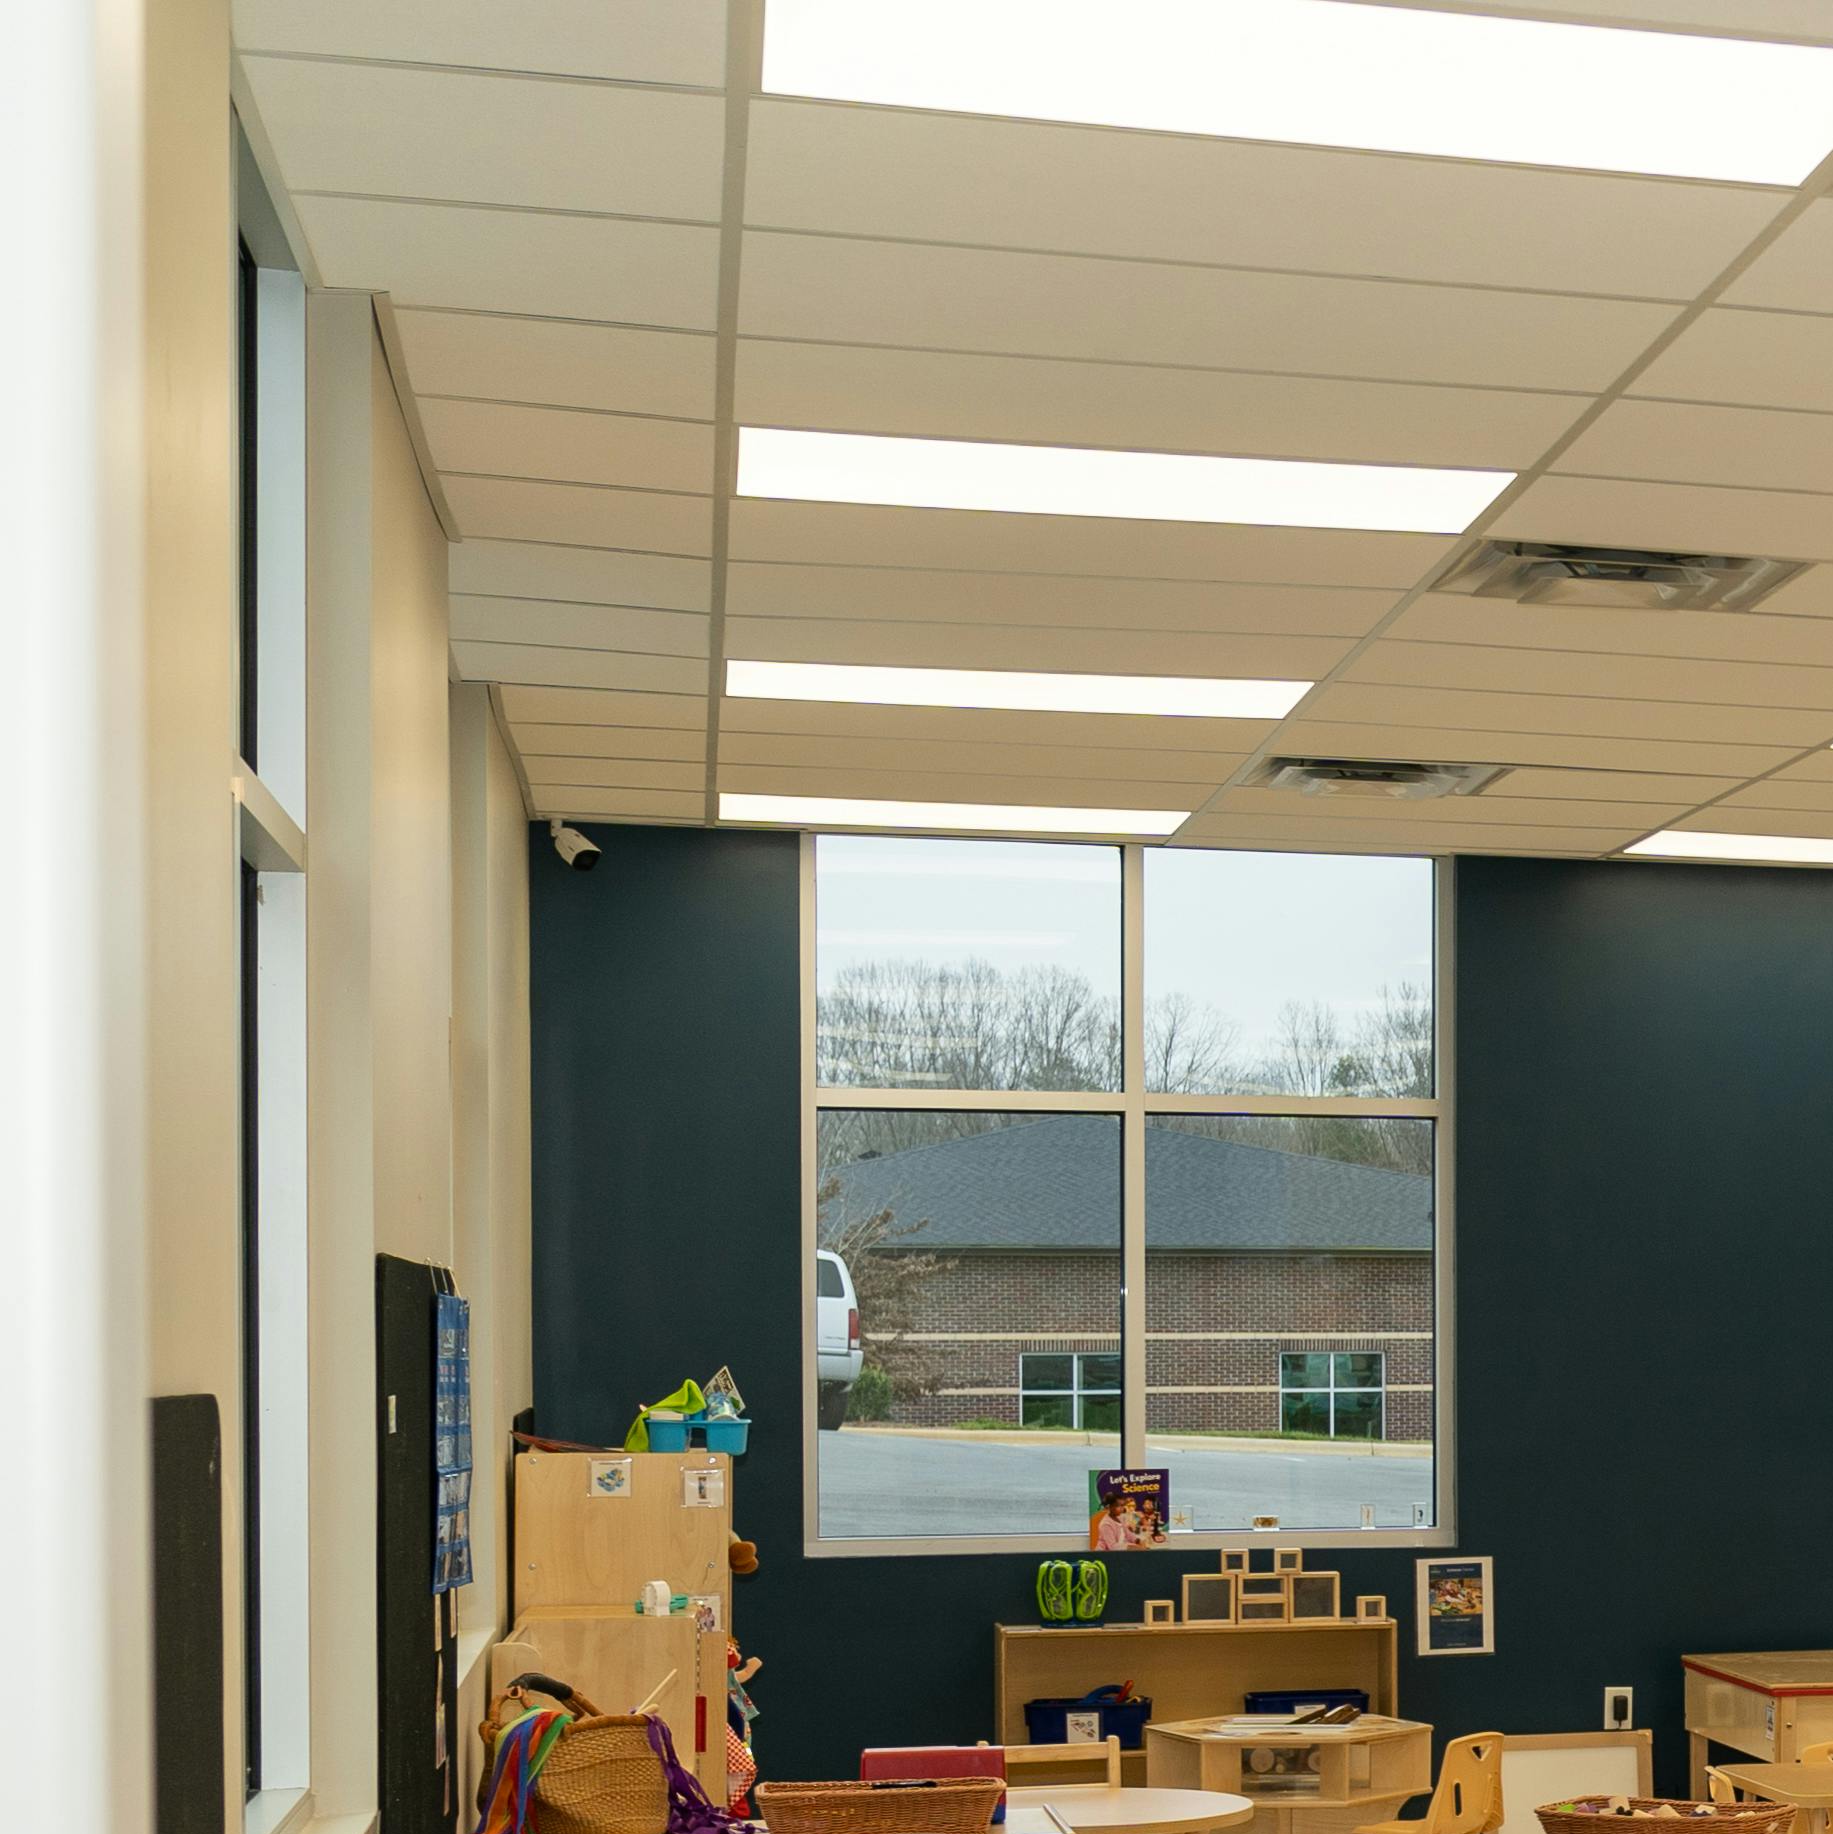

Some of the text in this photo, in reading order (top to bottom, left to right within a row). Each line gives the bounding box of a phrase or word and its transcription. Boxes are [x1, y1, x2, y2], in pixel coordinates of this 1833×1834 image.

[1110, 1473, 1161, 1484] Let's Explore
[1122, 1483, 1160, 1493] Science
